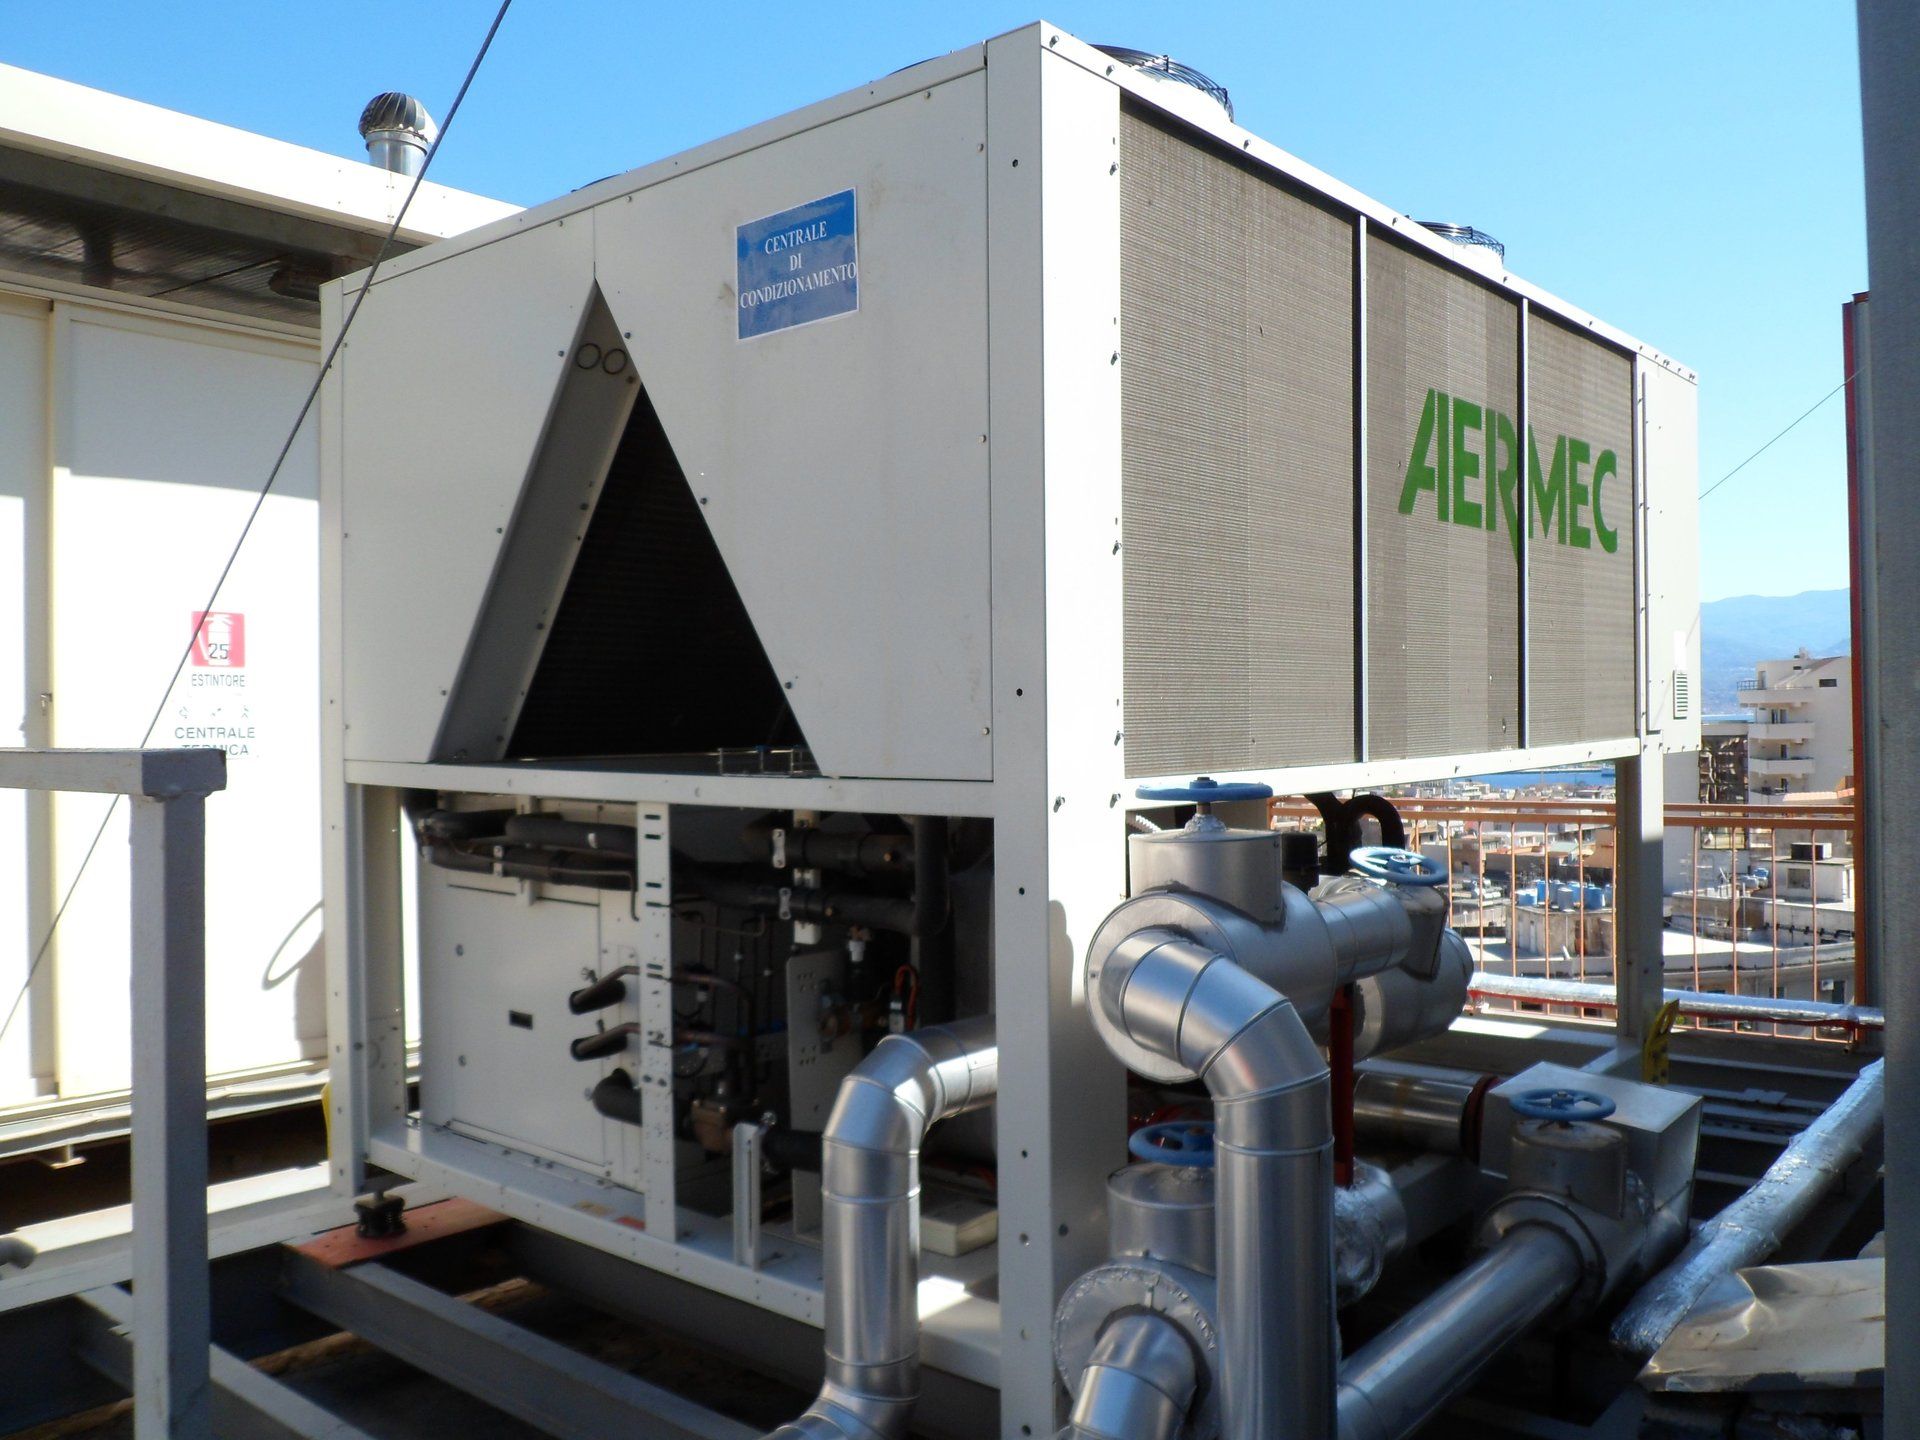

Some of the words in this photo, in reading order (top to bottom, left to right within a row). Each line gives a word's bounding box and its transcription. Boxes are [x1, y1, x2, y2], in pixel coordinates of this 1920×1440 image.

[765, 220, 827, 255] CENTRALE
[789, 253, 802, 272] DI
[740, 262, 857, 309] CONDIZIONAMENTO
[1398, 388, 1618, 565] AERMEC
[208, 643, 229, 660] 25
[191, 673, 246, 688] ESTINTORE
[174, 727, 256, 739] CENTRALE
